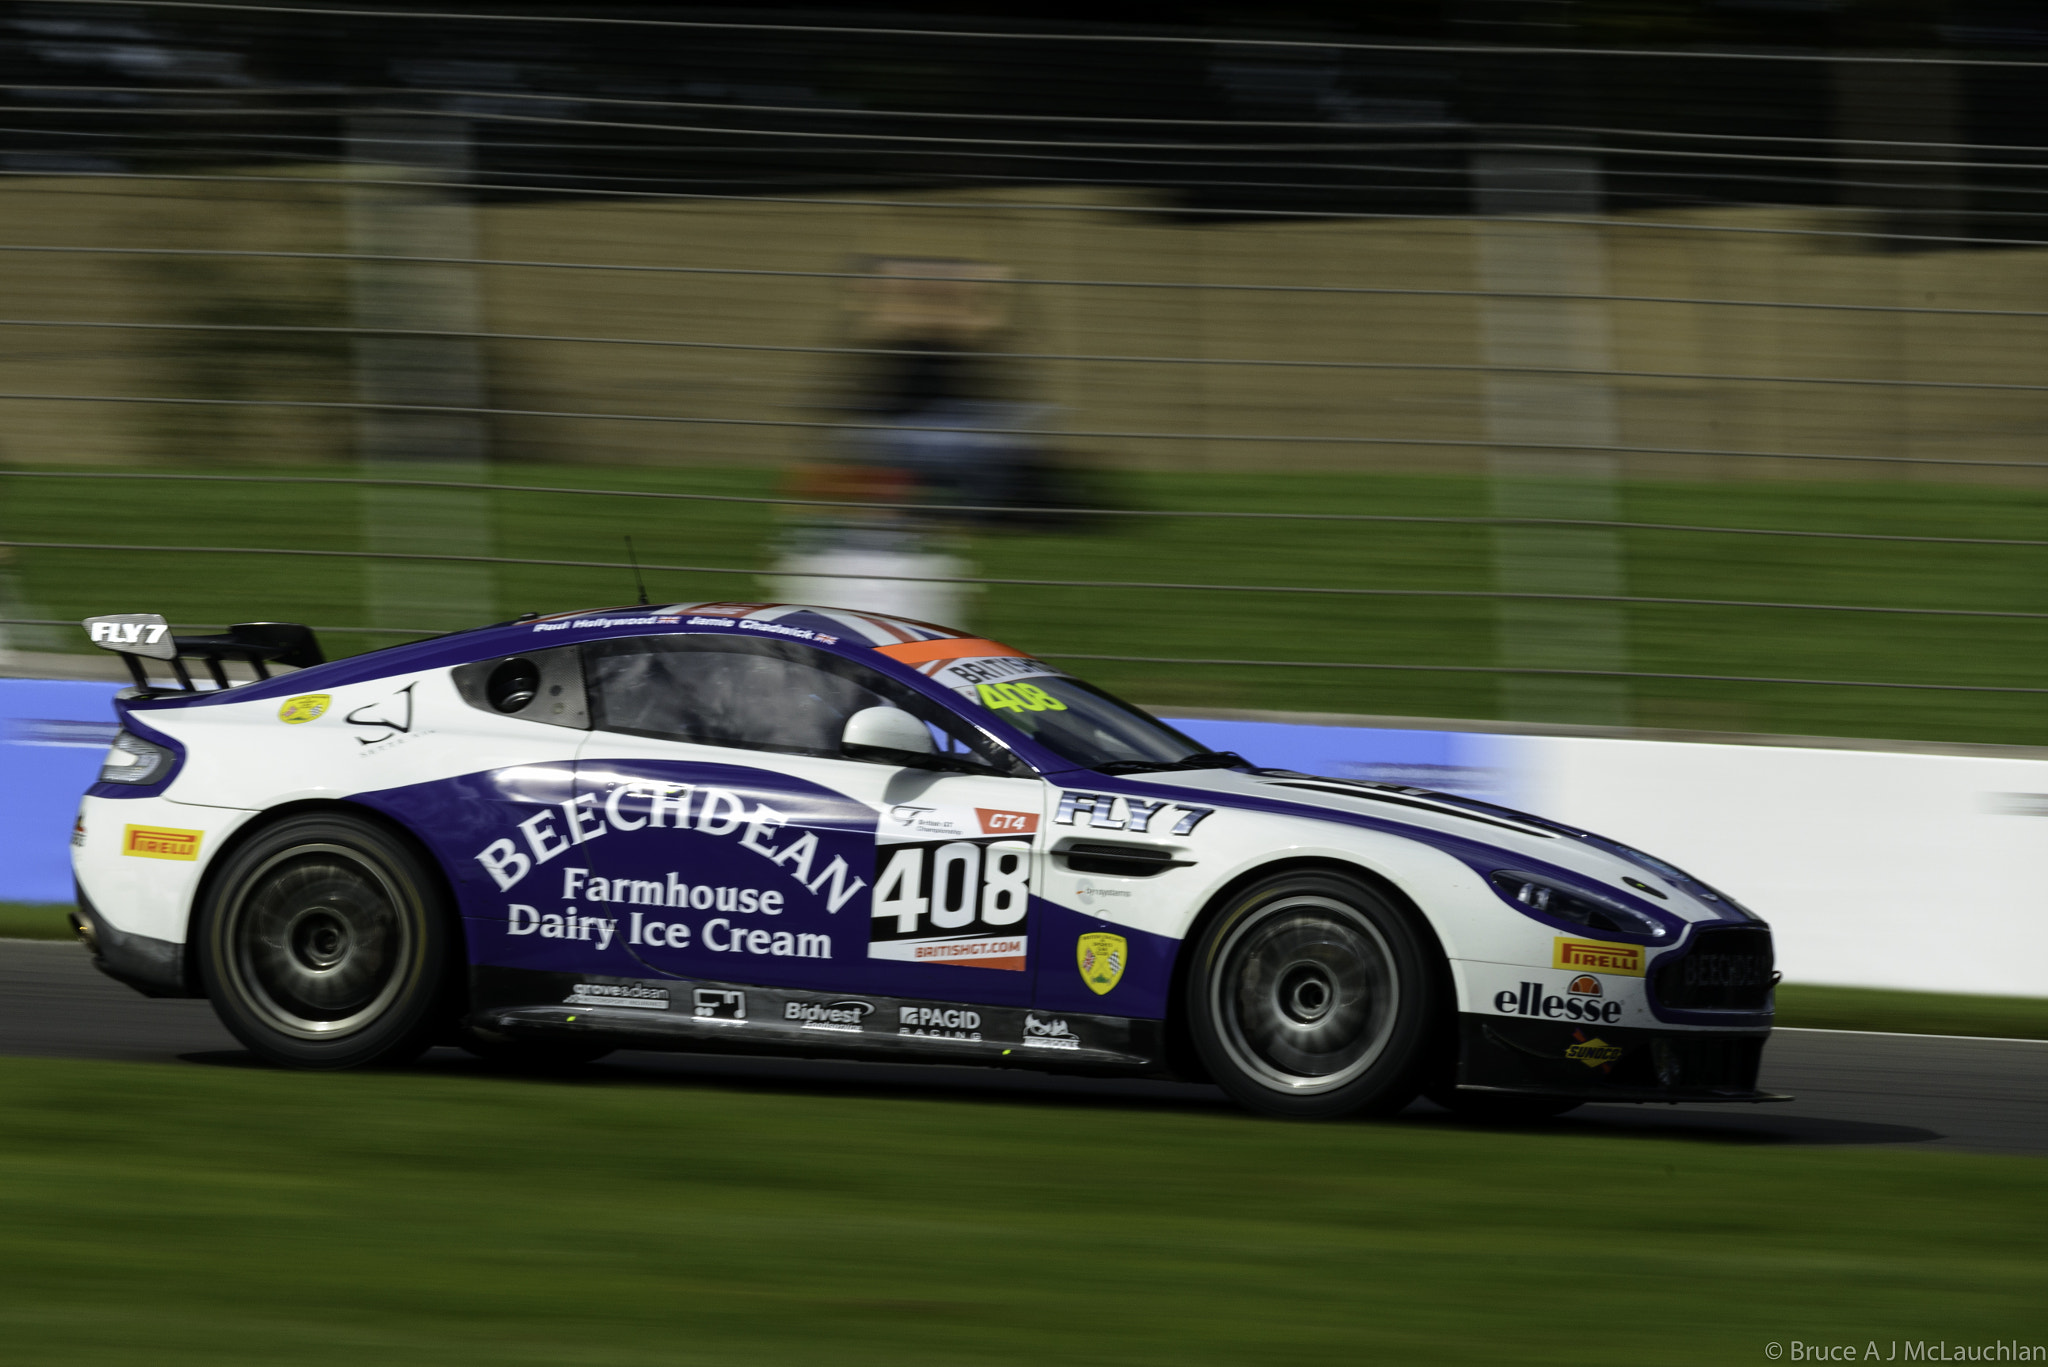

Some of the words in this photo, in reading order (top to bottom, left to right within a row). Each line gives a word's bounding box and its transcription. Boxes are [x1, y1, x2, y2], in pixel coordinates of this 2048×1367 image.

[532, 620, 571, 633] Paul
[572, 615, 658, 629] Hollywood
[686, 615, 736, 628] Jamie
[738, 619, 815, 640] Chadwick
[975, 682, 1068, 713] 408
[989, 813, 1027, 831] GT4
[130, 828, 198, 857] PIRELLI
[474, 782, 868, 915] BEECHDEAN
[561, 866, 786, 916] Farmhouse
[871, 840, 1031, 934] 408
[507, 903, 619, 951] Dairy
[627, 911, 691, 949] Ice
[701, 917, 834, 960] Cream
[914, 940, 1021, 959] BRITISHGT.COM
[1561, 942, 1639, 971] PIRELLI
[784, 1001, 863, 1024] Bidvest
[1494, 981, 1622, 1024] ellesse
[919, 1007, 982, 1030] PAGID
[899, 1027, 983, 1041] RACING
[1567, 1045, 1620, 1061] SUNOCO
